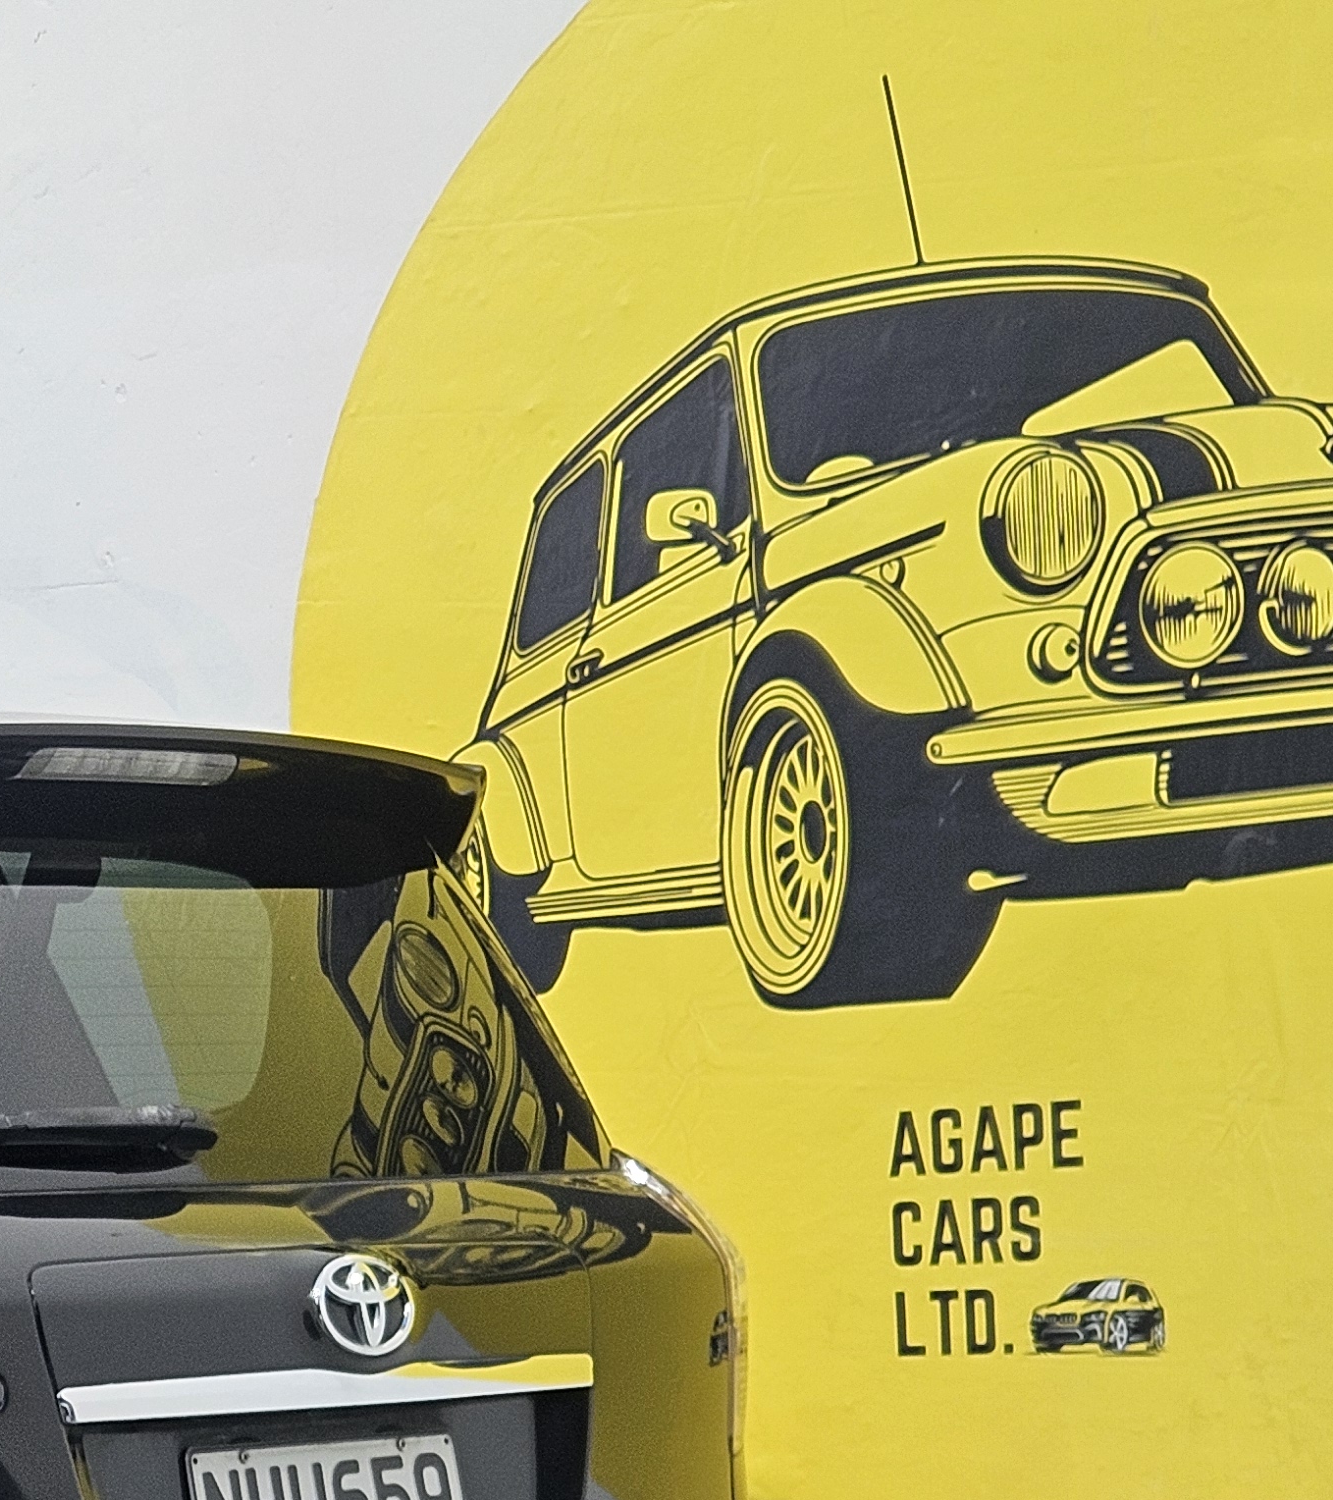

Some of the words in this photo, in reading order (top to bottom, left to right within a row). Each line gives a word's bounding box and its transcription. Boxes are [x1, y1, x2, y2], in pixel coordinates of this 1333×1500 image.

[889, 1099, 1085, 1178] AGAPE
[891, 1194, 1042, 1267] CARS
[895, 1288, 1014, 1357] LTD.
